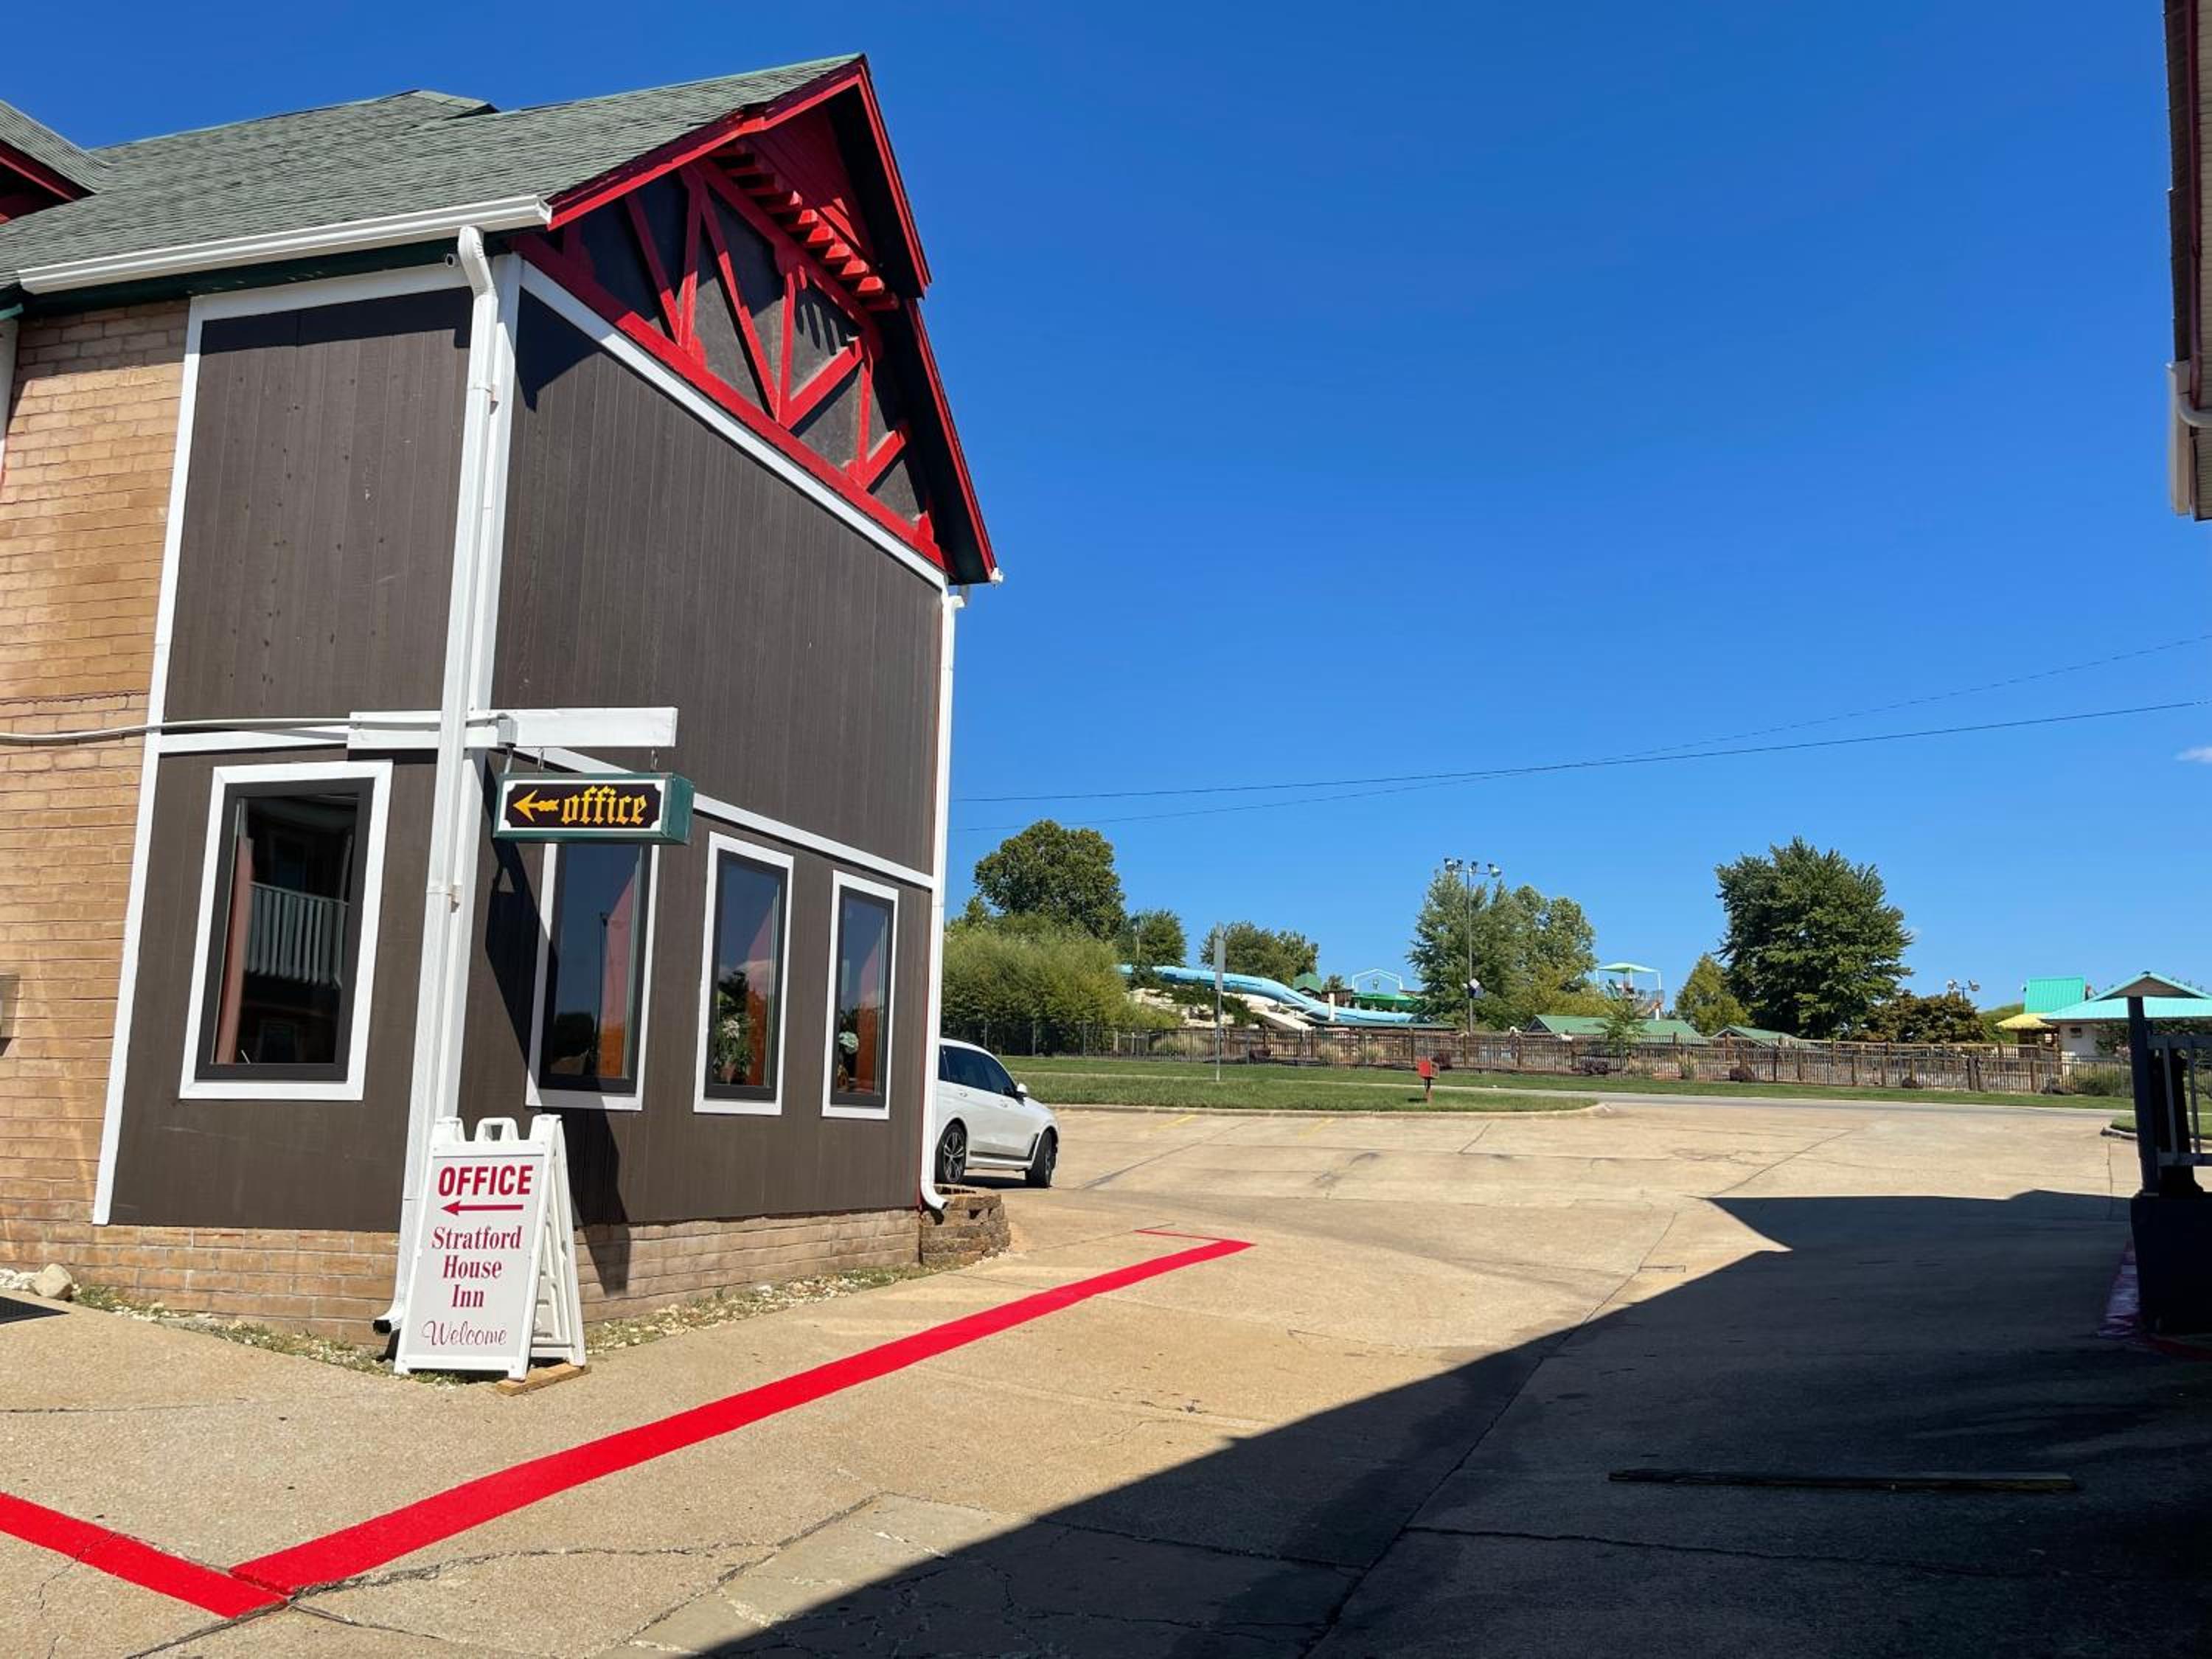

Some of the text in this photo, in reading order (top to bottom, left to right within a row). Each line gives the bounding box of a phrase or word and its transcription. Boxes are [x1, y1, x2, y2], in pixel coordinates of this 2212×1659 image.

[561, 785, 647, 825] office
[438, 1164, 534, 1197] OFFICE
[431, 1225, 523, 1251] Stratford
[442, 1255, 502, 1279] House
[451, 1284, 484, 1308] Inn
[421, 1320, 507, 1346] Welcome
